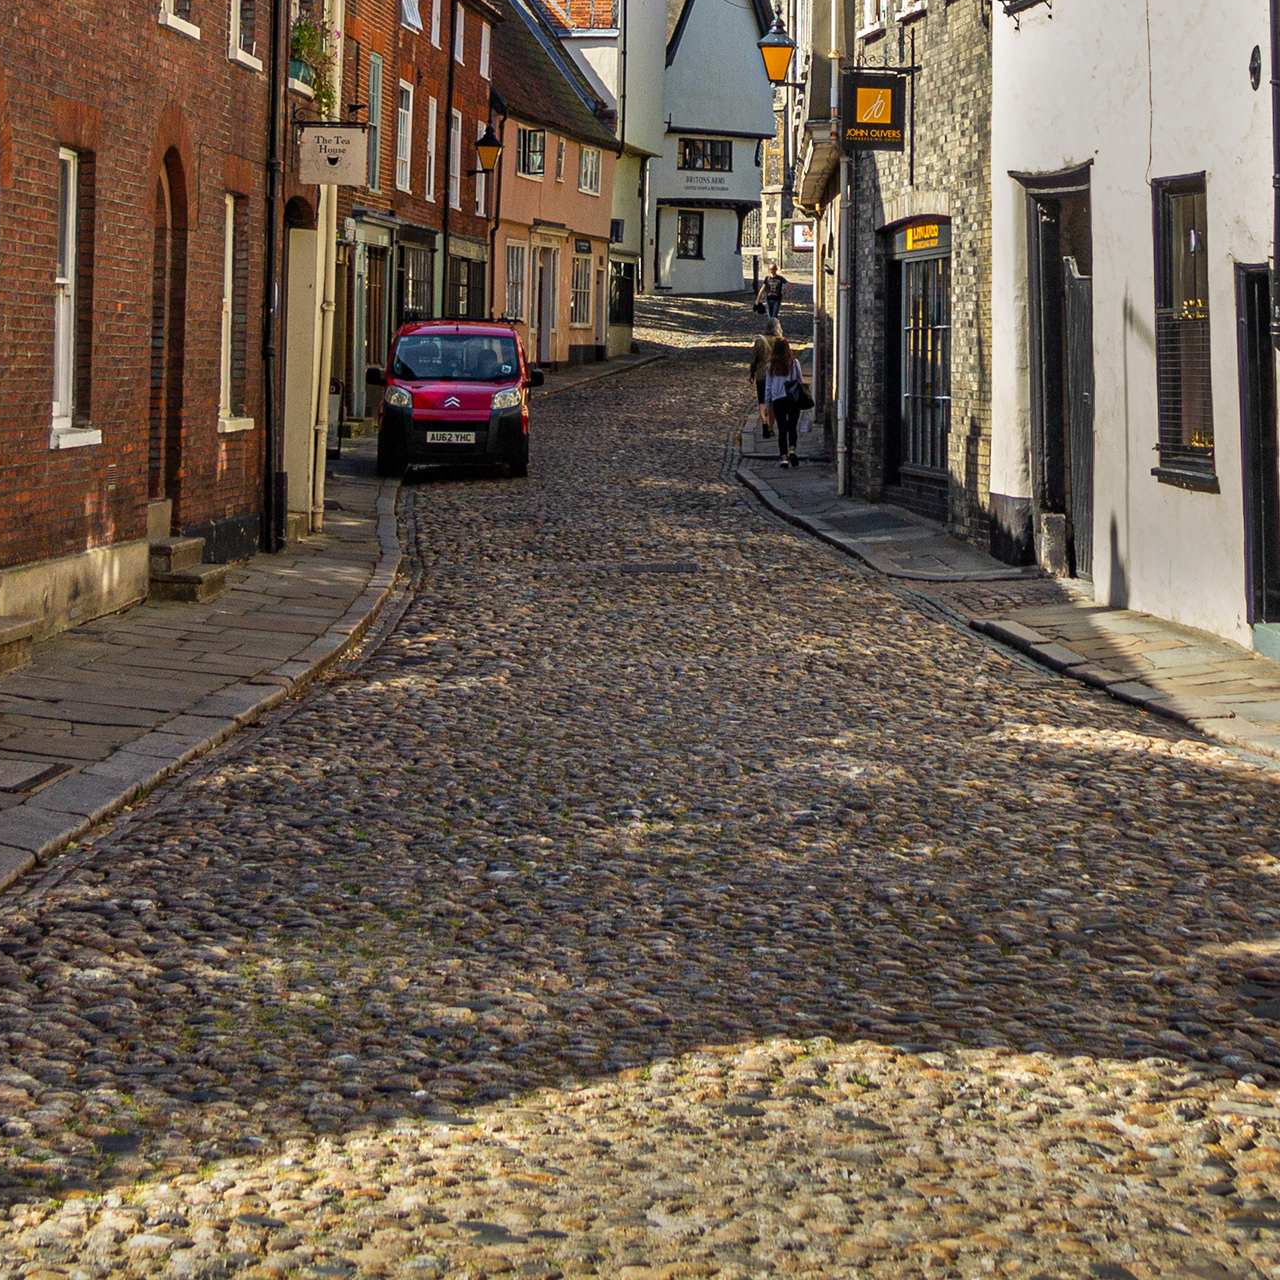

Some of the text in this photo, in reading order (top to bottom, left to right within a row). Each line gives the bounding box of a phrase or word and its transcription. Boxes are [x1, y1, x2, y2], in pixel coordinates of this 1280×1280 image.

[846, 129, 902, 138] JOHN OLIVERS
[315, 136, 350, 144] The Tea
[319, 145, 347, 154] House
[686, 176, 725, 185] BRITONS ARMS
[431, 433, 471, 441] AU62 YHC
